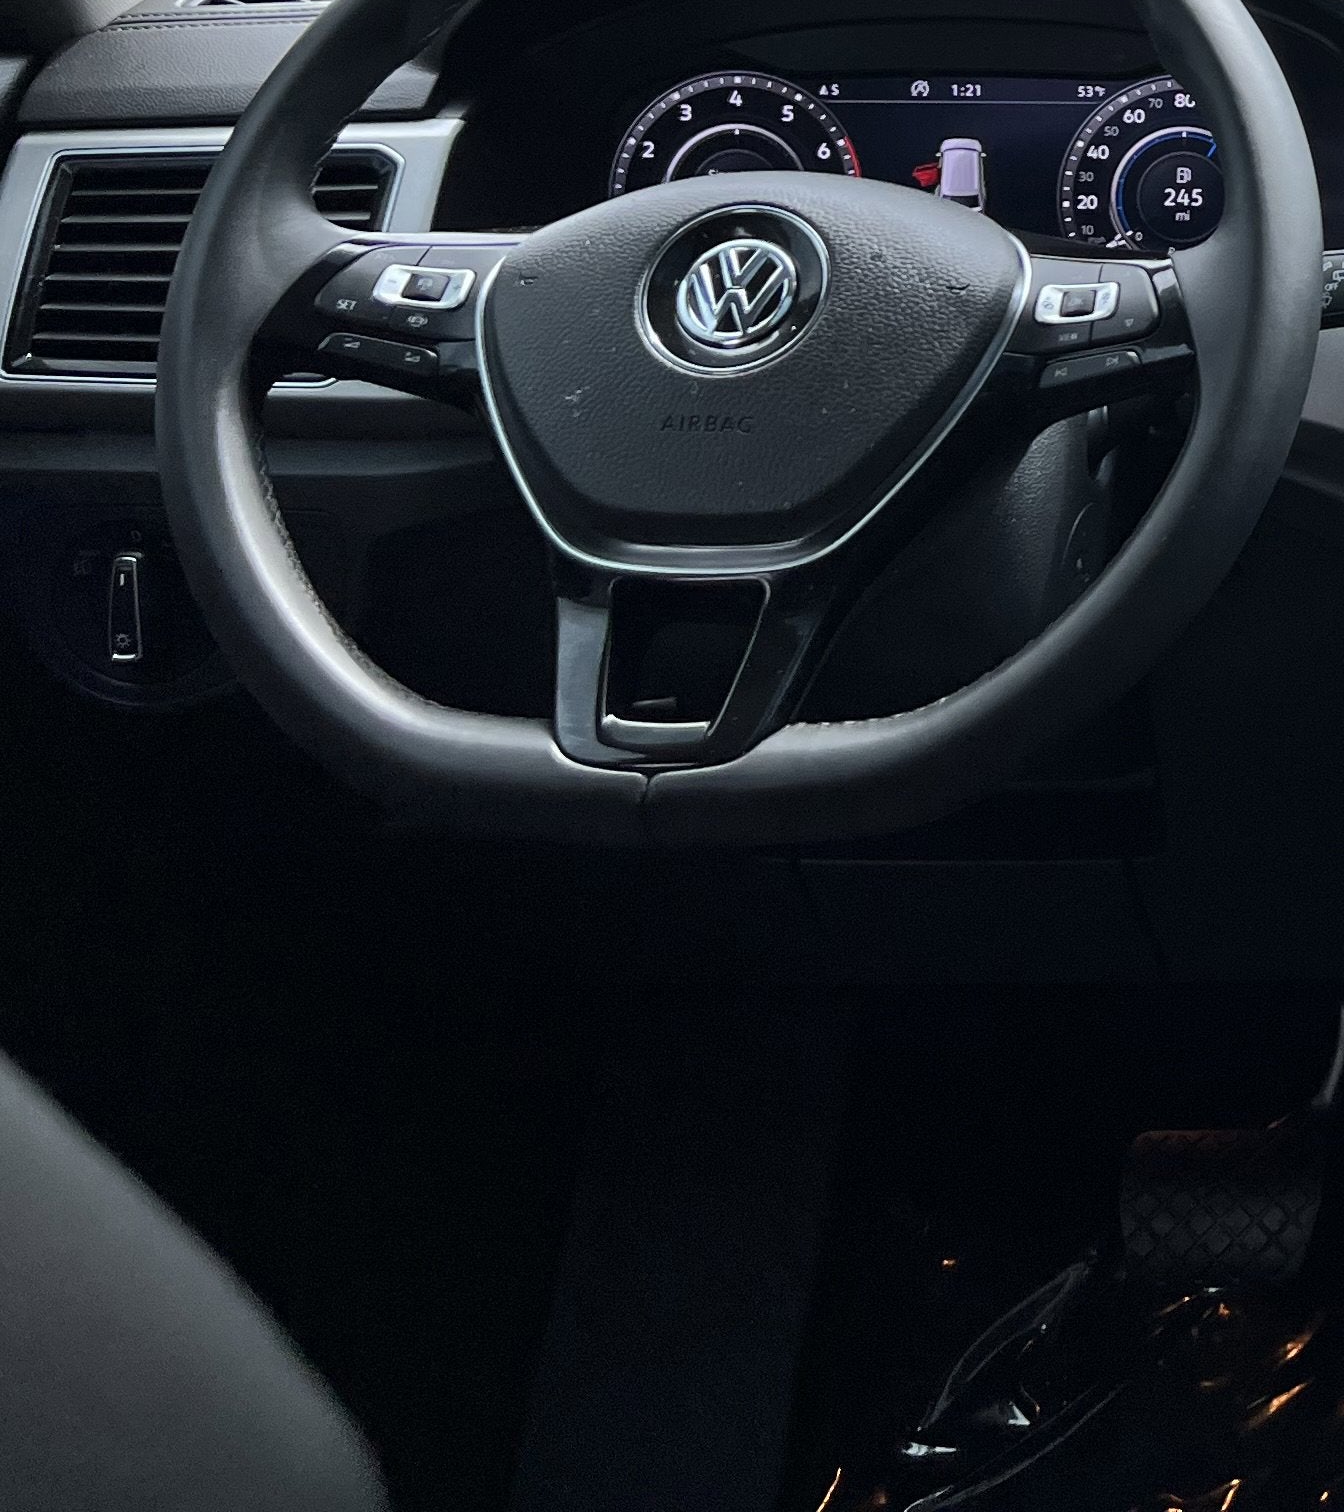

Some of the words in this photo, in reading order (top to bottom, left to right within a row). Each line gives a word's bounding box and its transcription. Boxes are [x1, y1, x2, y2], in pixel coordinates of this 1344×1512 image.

[728, 90, 743, 107] 4
[950, 84, 982, 97] 1:21
[1148, 97, 1164, 109] 70
[680, 104, 693, 122] 3
[781, 104, 794, 123] 5
[1122, 108, 1146, 124] 60
[1103, 125, 1120, 137] 50
[641, 141, 655, 159] 2
[816, 143, 831, 160] 6
[1086, 144, 1110, 160] 40
[1078, 171, 1095, 182] 30
[1076, 195, 1099, 210] 20
[1163, 188, 1204, 207] 245
[1175, 210, 1191, 221] mi
[1081, 224, 1095, 236] 10
[336, 298, 358, 312] SET
[659, 415, 754, 435] AIRBAG
